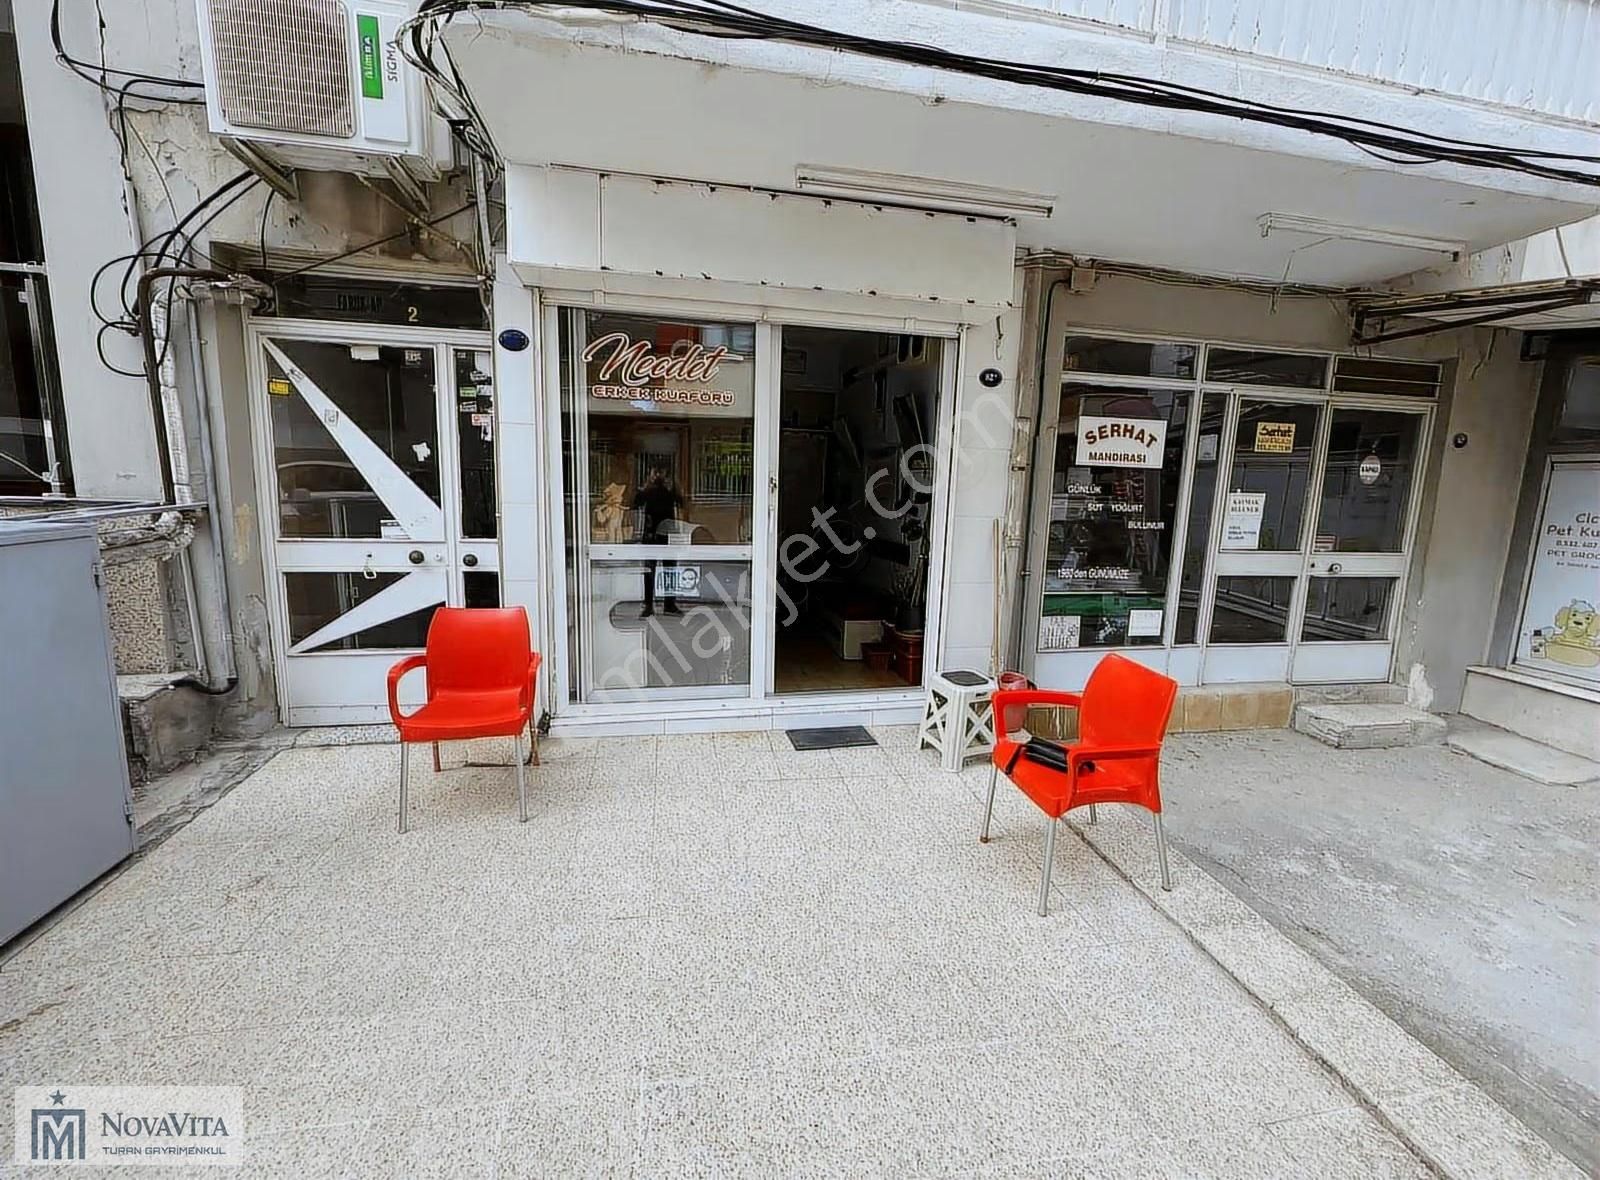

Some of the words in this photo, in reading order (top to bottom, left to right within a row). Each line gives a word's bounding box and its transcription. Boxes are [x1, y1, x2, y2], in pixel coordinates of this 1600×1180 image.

[408, 306, 419, 322] 2
[581, 332, 744, 386] Necdet
[592, 385, 650, 400] ERKEK
[1084, 423, 1158, 449] SERHAT
[1088, 451, 1147, 464] MANDIRASI
[1547, 524, 1573, 536] Pet
